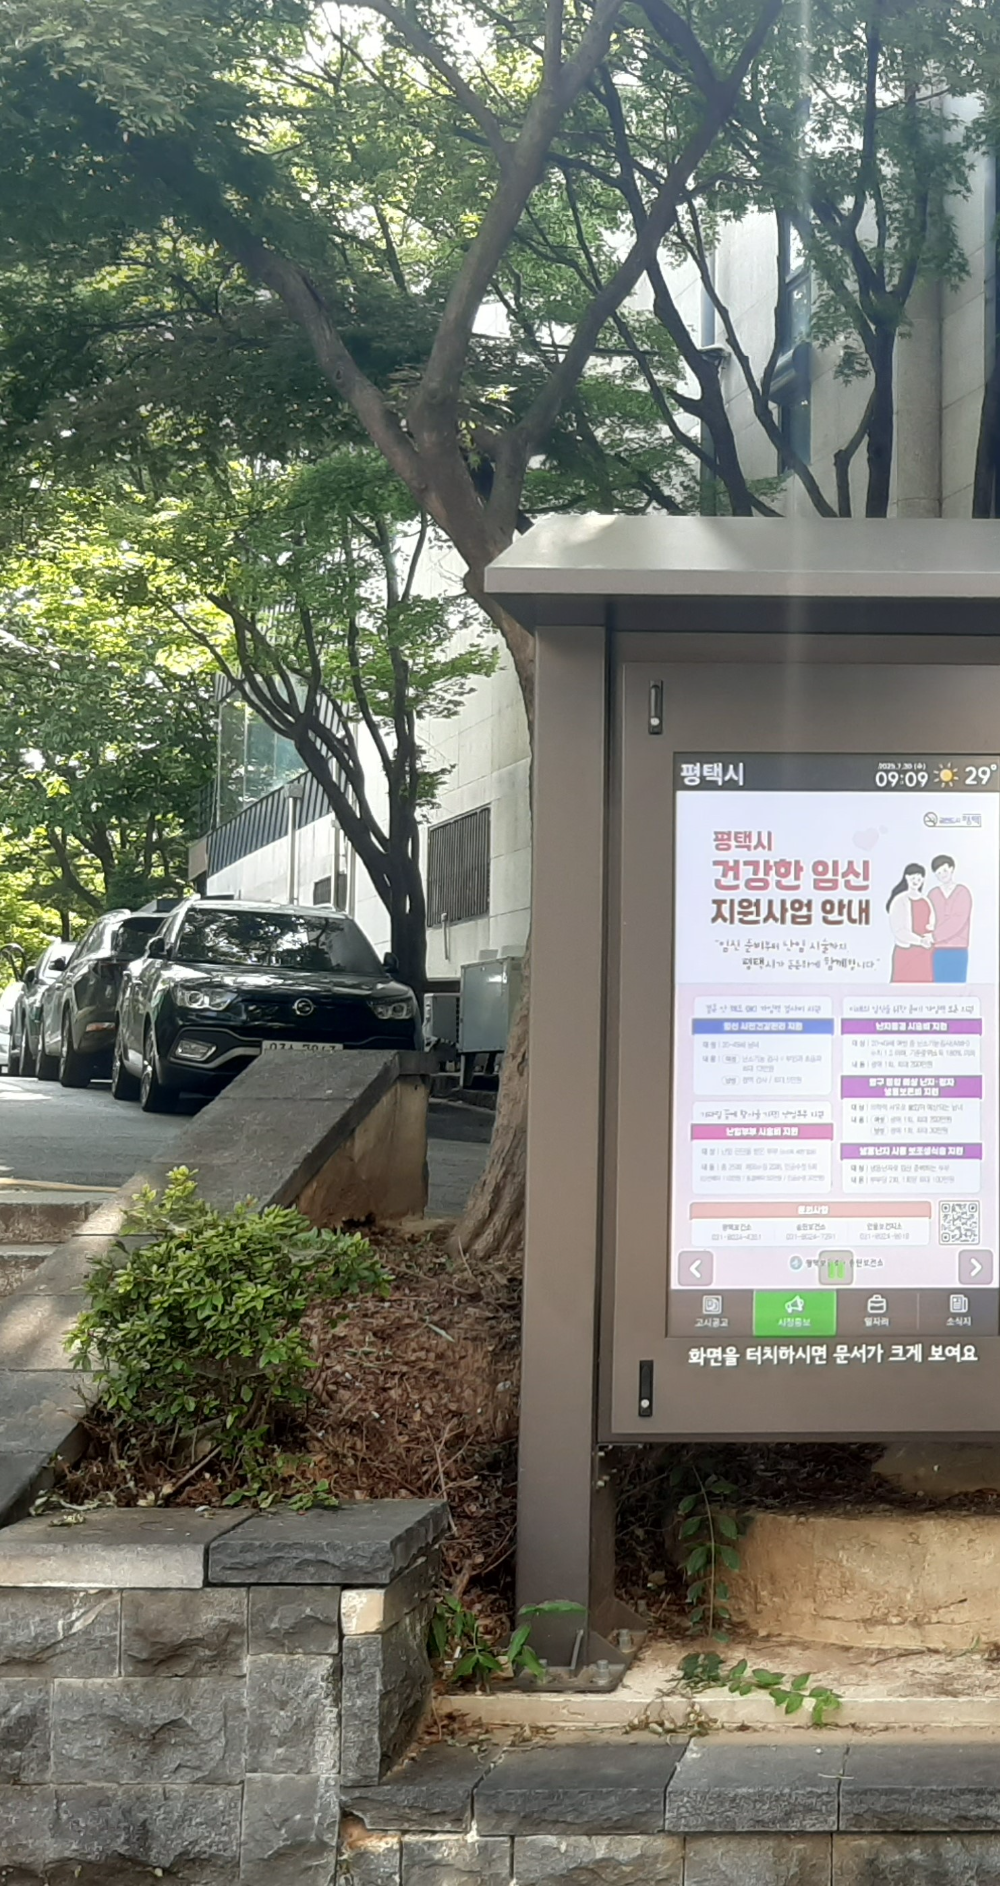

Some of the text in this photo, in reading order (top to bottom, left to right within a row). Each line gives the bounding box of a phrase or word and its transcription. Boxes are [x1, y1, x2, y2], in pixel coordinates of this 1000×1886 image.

[680, 762, 744, 786] 평택시
[875, 772, 928, 787] 09:09
[713, 831, 772, 852] 평택시
[712, 859, 871, 891] 건강한 임신
[711, 899, 871, 926] 지원사업 안내
[695, 1317, 728, 1328] 고시공고
[778, 1317, 811, 1327] 시정홍보
[864, 1316, 889, 1327] 일자리
[946, 1316, 972, 1326] 소식지
[688, 1343, 979, 1366] 화면을 터치하시면 문서가 크게 보여요
